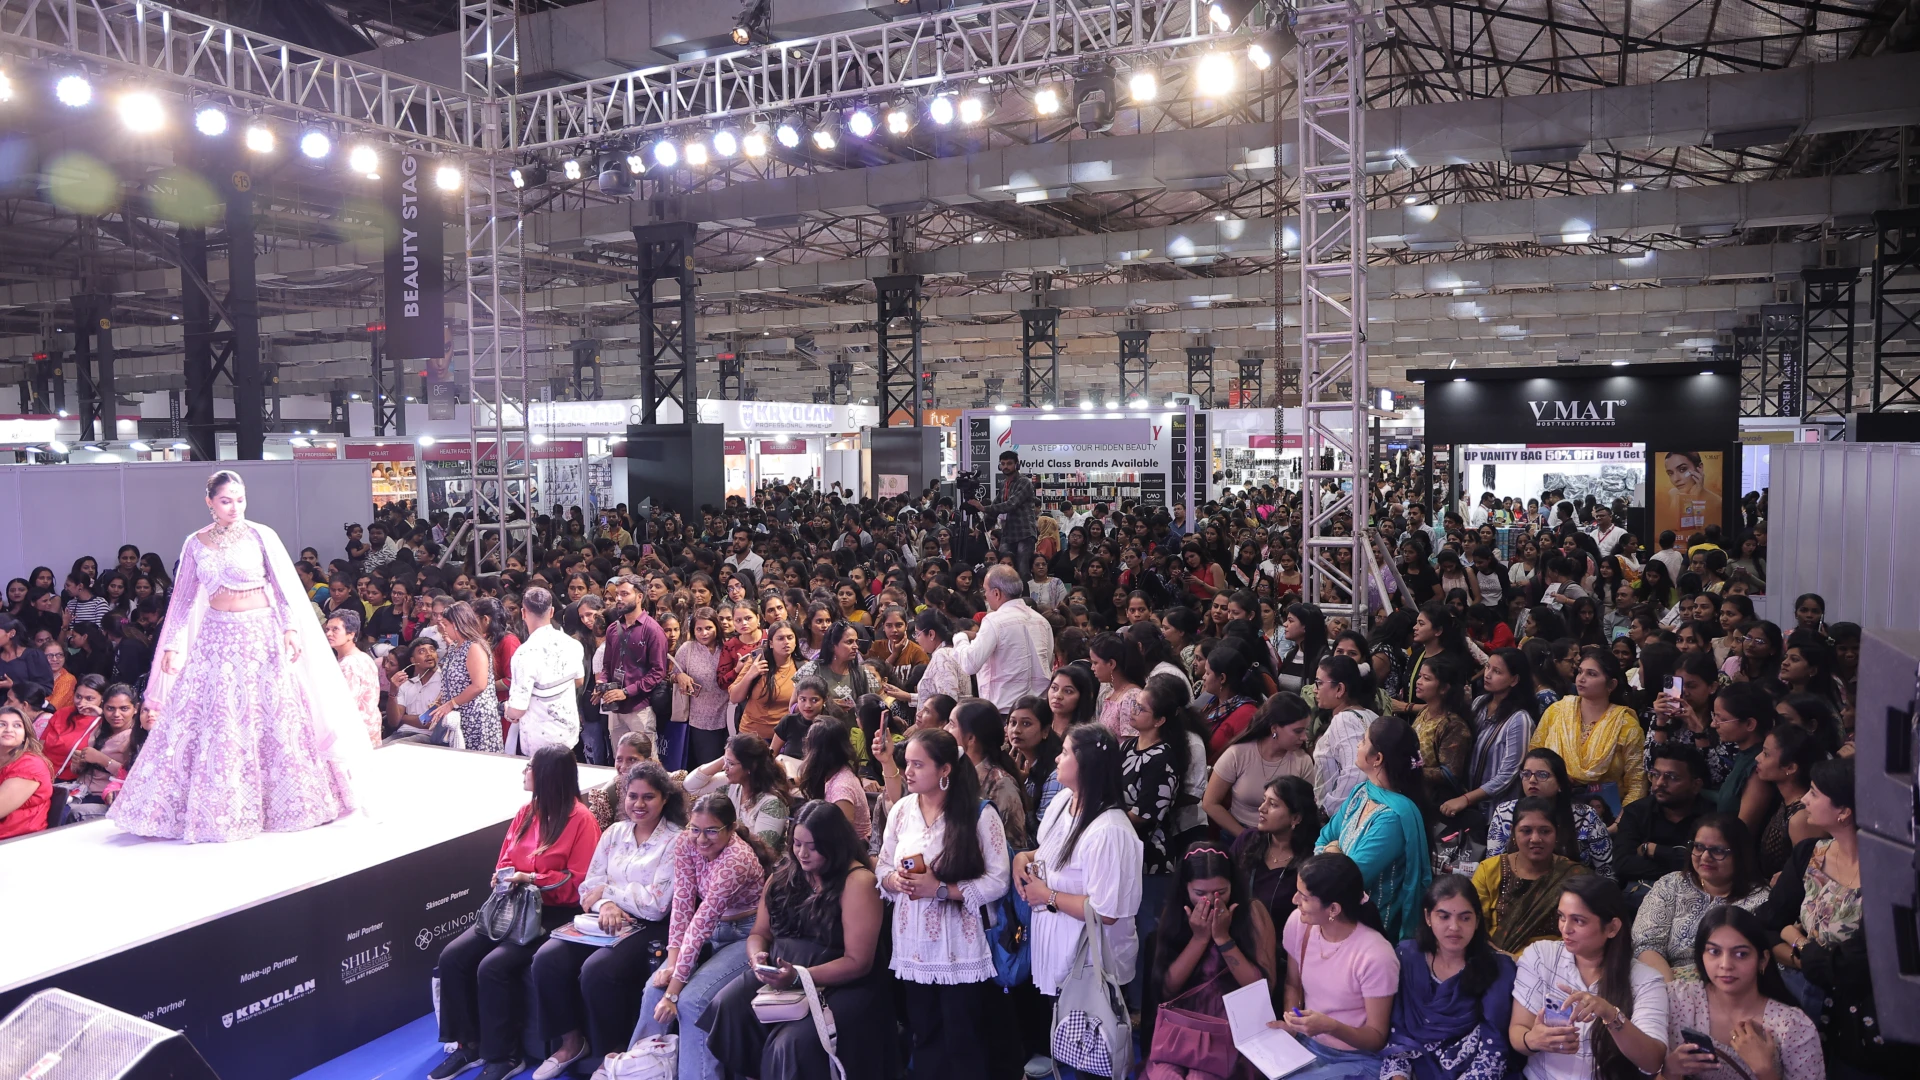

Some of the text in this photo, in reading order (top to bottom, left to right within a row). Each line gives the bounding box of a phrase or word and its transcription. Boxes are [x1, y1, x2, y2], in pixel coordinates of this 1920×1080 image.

[401, 151, 420, 317] BEAUTY STAG
[532, 404, 622, 422] KYOLAN
[755, 405, 834, 422] KRYOLAN
[1528, 400, 1548, 420] V
[970, 444, 986, 454] REZ
[1176, 444, 1202, 454] Dor
[1465, 452, 1478, 461] UP
[1480, 451, 1517, 461] VANITY
[1520, 451, 1542, 460] BAG
[1546, 450, 1572, 460] 50%
[1574, 450, 1594, 460] OFF
[1597, 450, 1614, 460] Buy
[1624, 450, 1640, 458] Get
[1018, 458, 1158, 468] World Class Brands Available
[426, 888, 470, 910] Skincare Partner
[346, 922, 384, 941] Nail Partner
[240, 955, 298, 984] Make-up Partner
[342, 954, 392, 978] PROFESSIONAL
[139, 998, 186, 1020] ols Partner
[236, 978, 316, 1020] KRYOLAN
[236, 988, 316, 1024] PROFESSIONAL MAKE-UP
